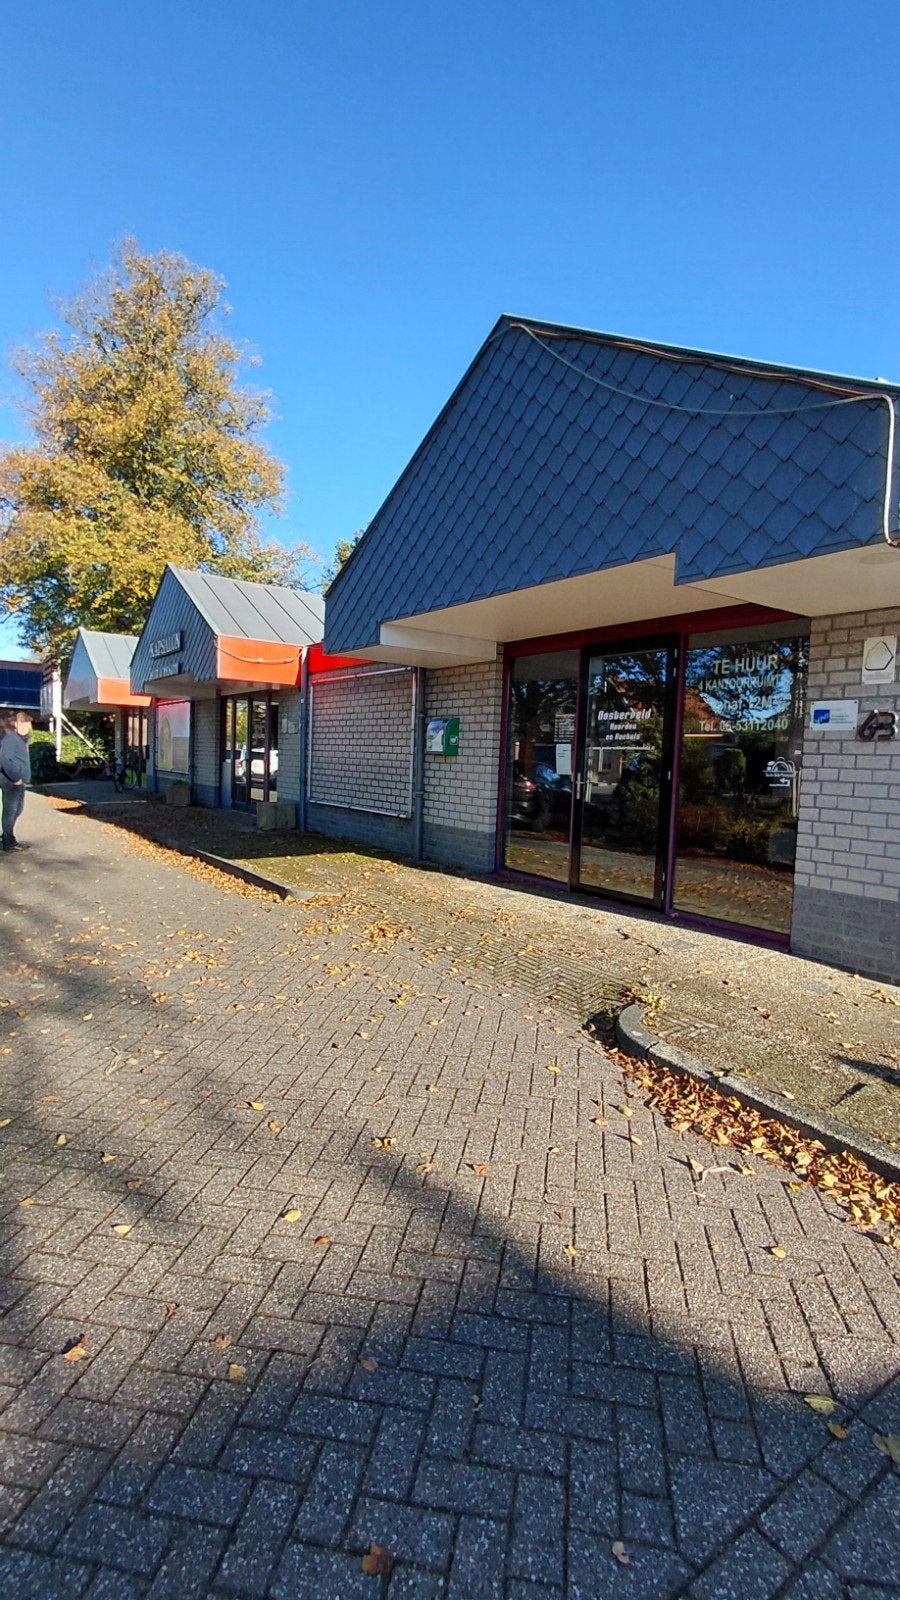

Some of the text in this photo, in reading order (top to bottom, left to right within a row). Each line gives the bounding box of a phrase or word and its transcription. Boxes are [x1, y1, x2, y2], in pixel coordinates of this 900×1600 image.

[713, 654, 778, 675] TE HUUR
[598, 708, 652, 720] Oosterveld
[859, 709, 897, 741] 63
